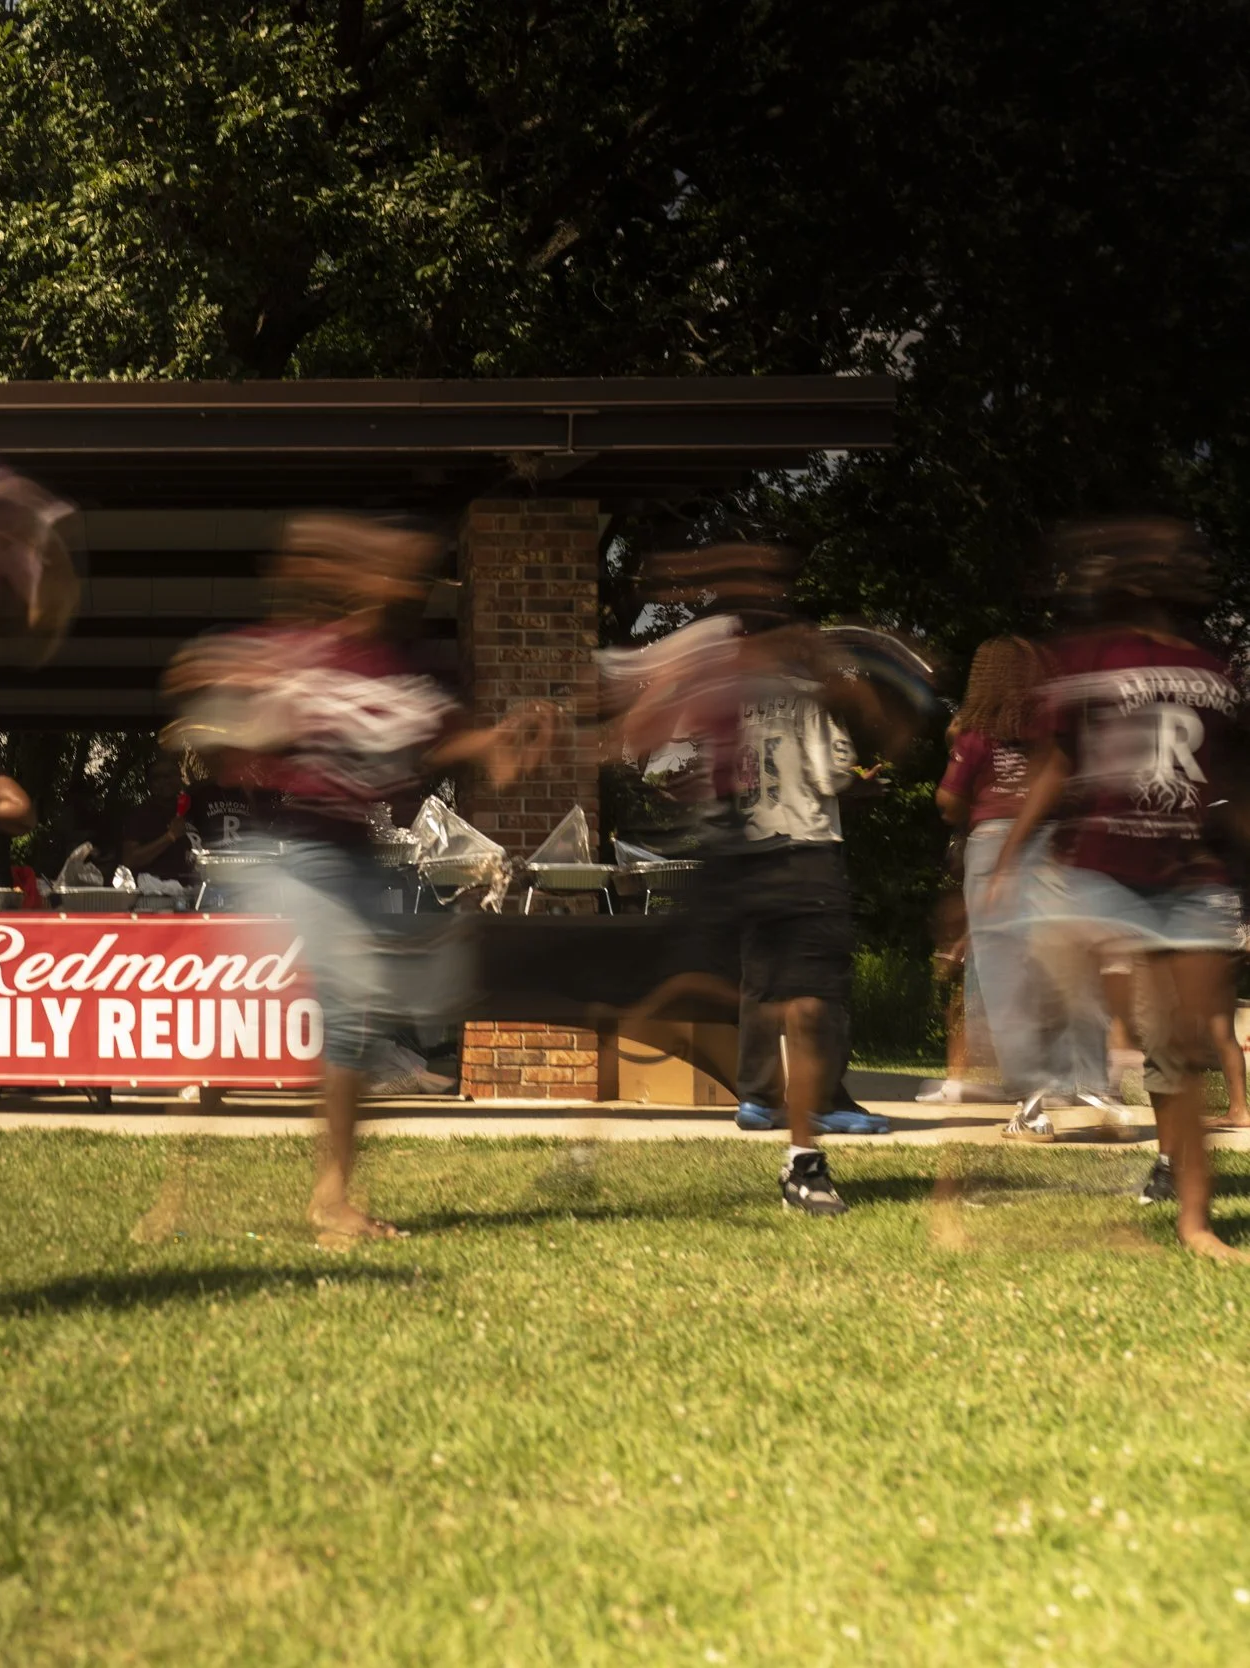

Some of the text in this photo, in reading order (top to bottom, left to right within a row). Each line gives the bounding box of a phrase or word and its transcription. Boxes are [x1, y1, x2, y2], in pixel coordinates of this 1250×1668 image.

[1174, 692, 1238, 719] REUNIO
[1159, 702, 1209, 784] R
[223, 815, 243, 841] R
[97, 997, 324, 1061] REUNIO
